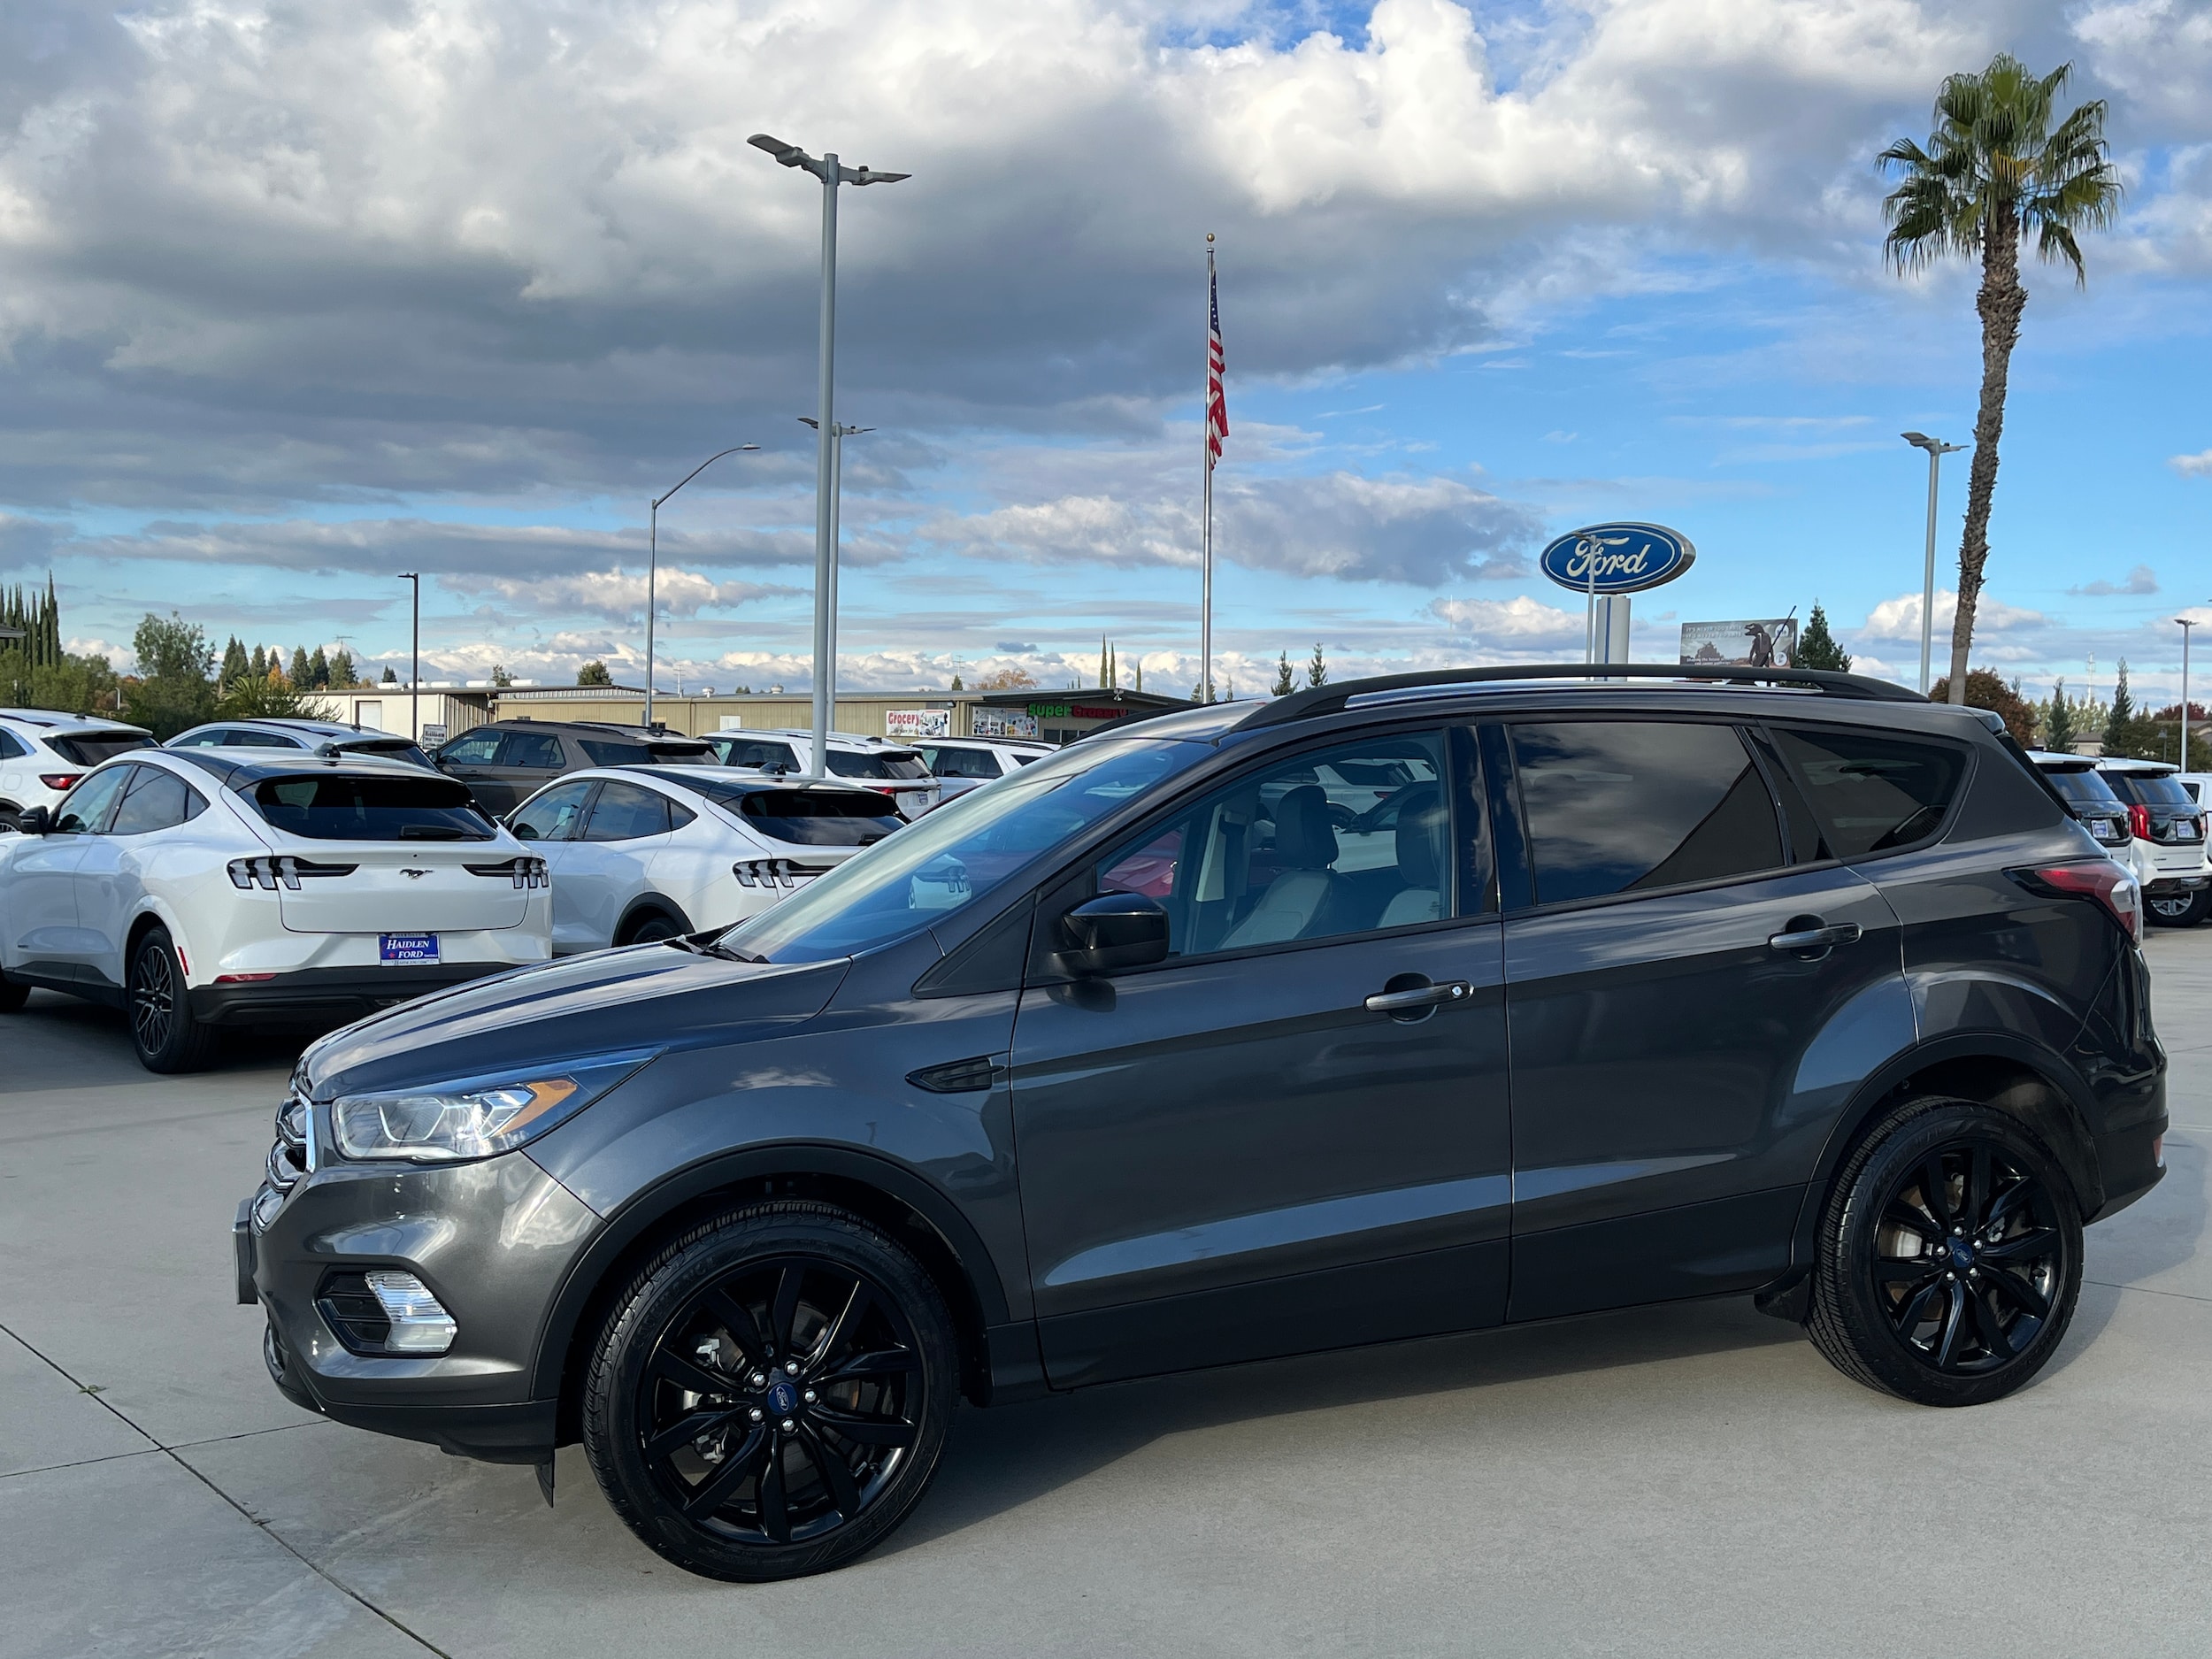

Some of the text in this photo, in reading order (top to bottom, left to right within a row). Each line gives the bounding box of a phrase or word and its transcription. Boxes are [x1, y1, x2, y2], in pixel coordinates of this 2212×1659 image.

[1566, 535, 1651, 577] Ford
[1028, 703, 1127, 718] Super Grocery
[888, 712, 919, 726] Grocery
[387, 940, 429, 949] HAIDLEN
